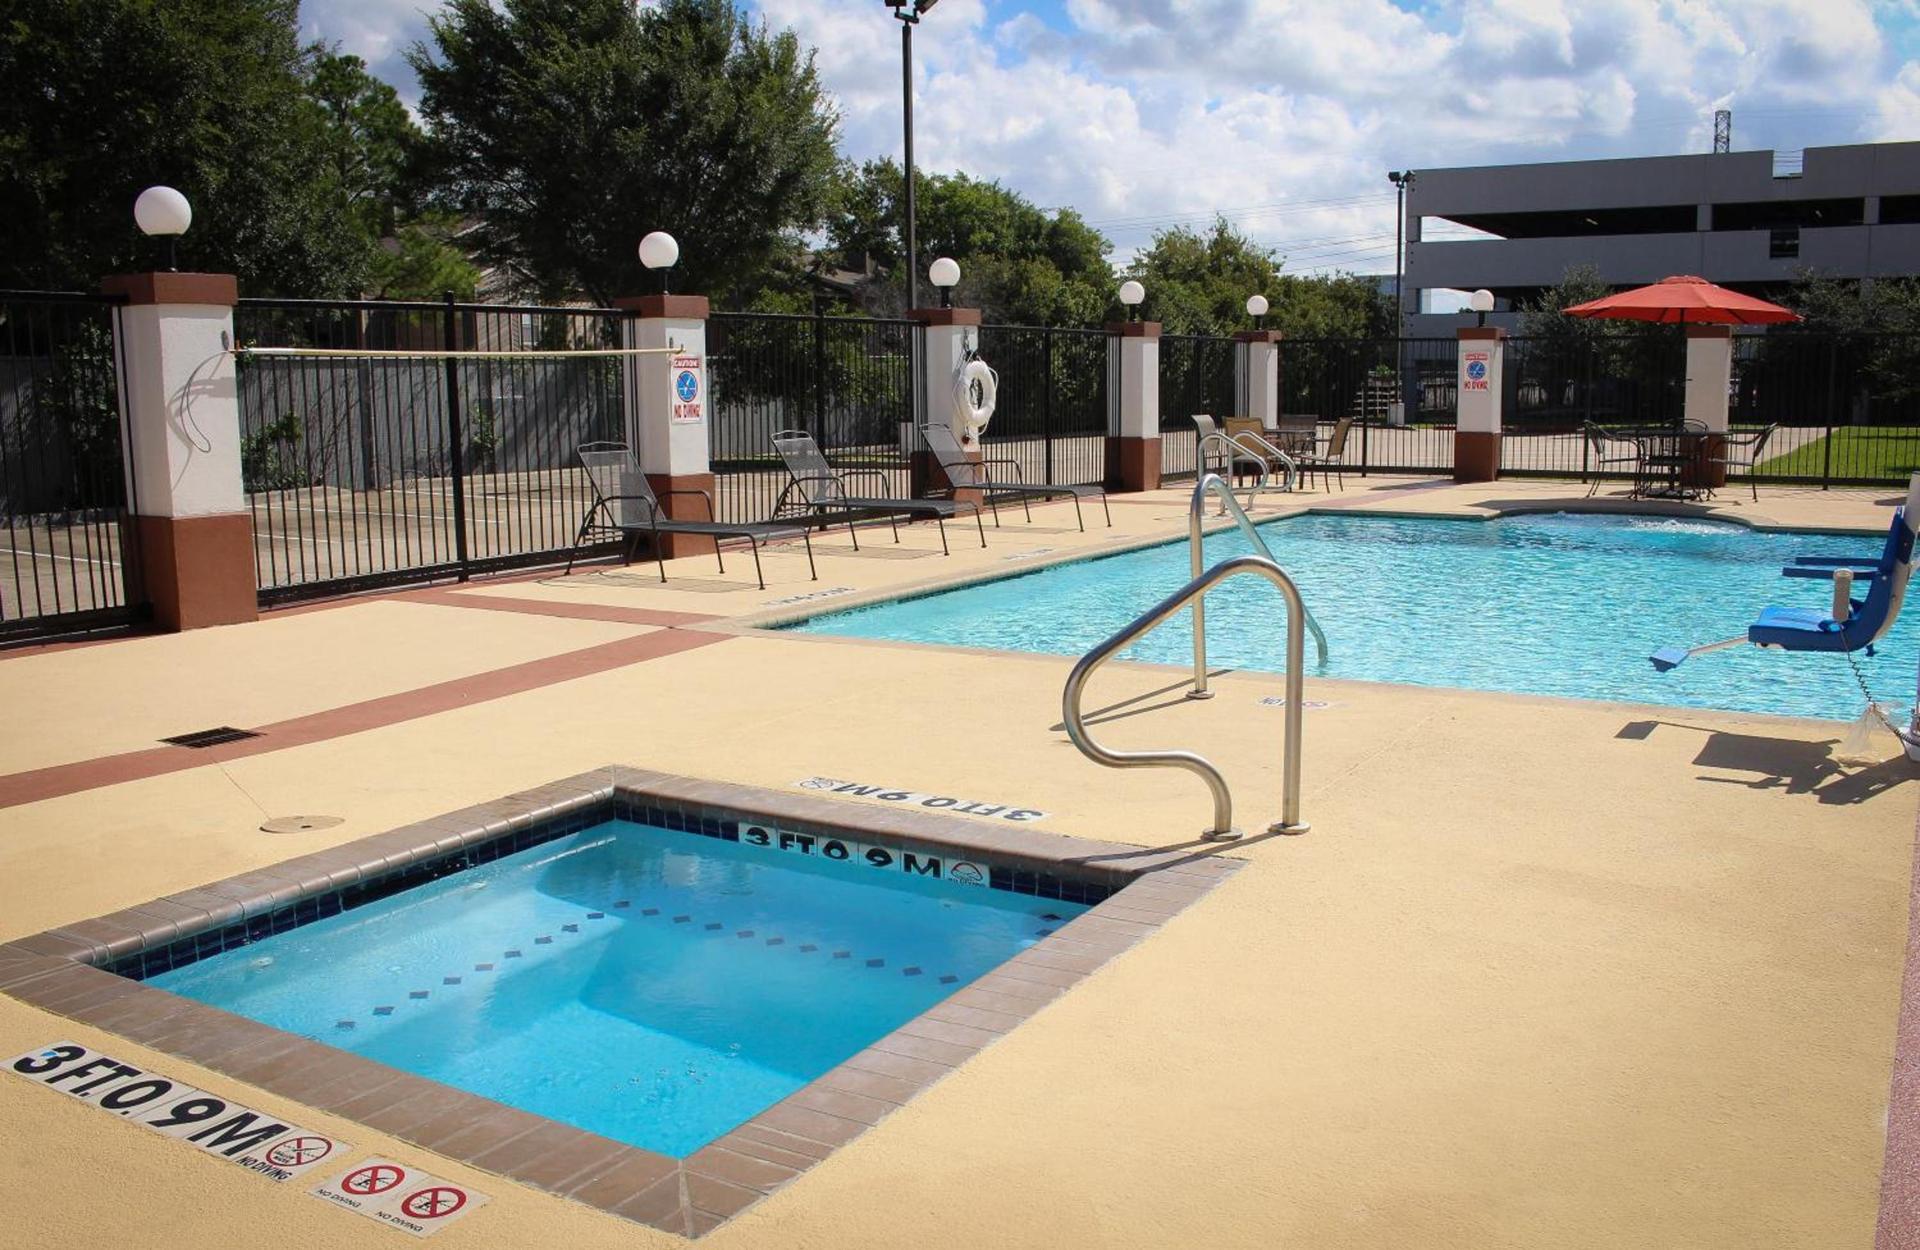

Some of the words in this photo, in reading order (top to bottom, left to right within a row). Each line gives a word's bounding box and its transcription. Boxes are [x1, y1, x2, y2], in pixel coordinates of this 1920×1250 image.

[832, 783, 883, 796] M
[1003, 810, 1042, 821] 3
[744, 826, 771, 846] 3
[903, 853, 941, 878] M
[14, 1045, 87, 1073] 3
[186, 1111, 290, 1156] M
[237, 1155, 259, 1168] NO
[252, 1160, 292, 1182] DIVING
[317, 1188, 332, 1199] NO
[330, 1194, 362, 1209] DIVING
[376, 1210, 391, 1221] NO
[391, 1217, 424, 1233] DIVING
